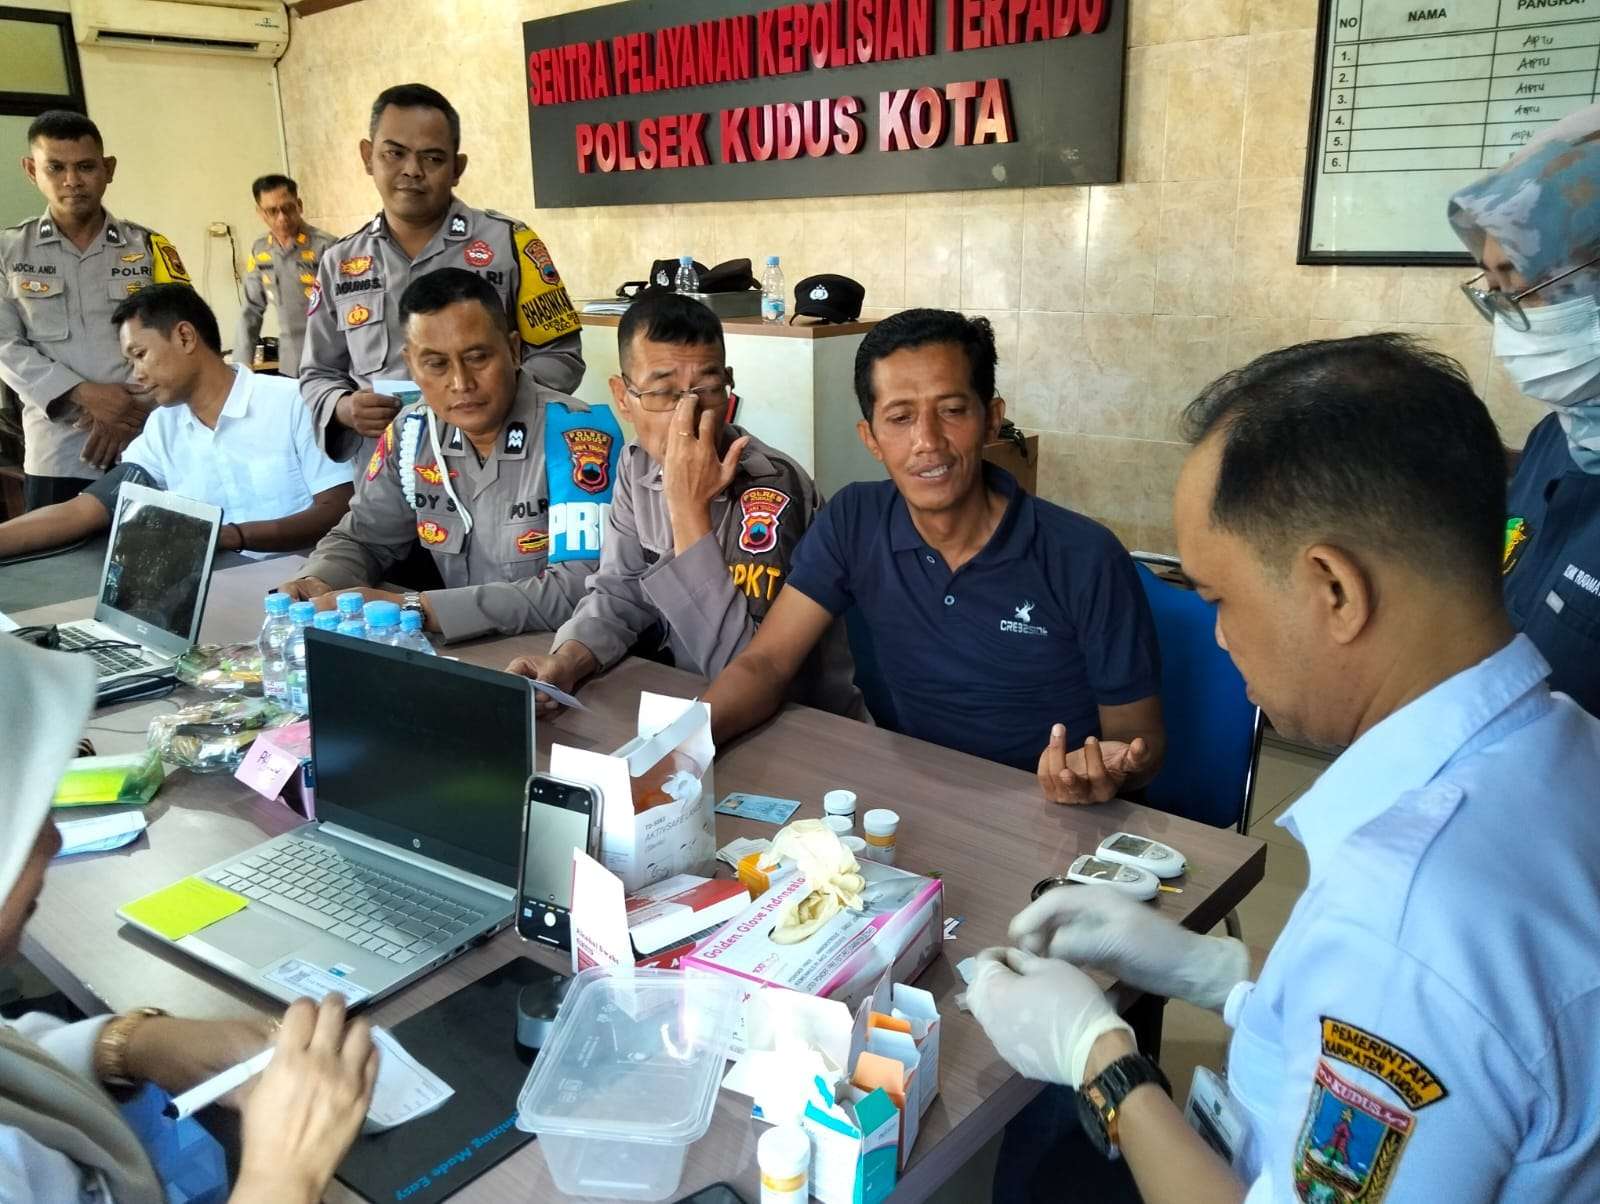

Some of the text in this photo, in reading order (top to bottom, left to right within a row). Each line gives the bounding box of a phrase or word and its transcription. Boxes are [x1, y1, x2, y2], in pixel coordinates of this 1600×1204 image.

[1339, 8, 1447, 29] NO NAMA
[529, 41, 611, 106] SENTRA
[613, 14, 756, 96] PELAYANAN
[759, 0, 932, 75] KEPOLISIAN
[1341, 50, 1351, 62] 1.
[1338, 72, 1350, 84] 2.
[1336, 94, 1348, 105] 3.
[575, 77, 1018, 174] POLSEK KUDUS KOTA
[1334, 115, 1346, 126] 4.
[1332, 136, 1344, 147] 5.
[1331, 157, 1343, 168] 6.
[548, 501, 611, 556] PR
[728, 562, 782, 601] PKT
[703, 933, 743, 959] Golden
[736, 910, 767, 933] Glove
[1331, 1023, 1435, 1090] PEMERINTAH
